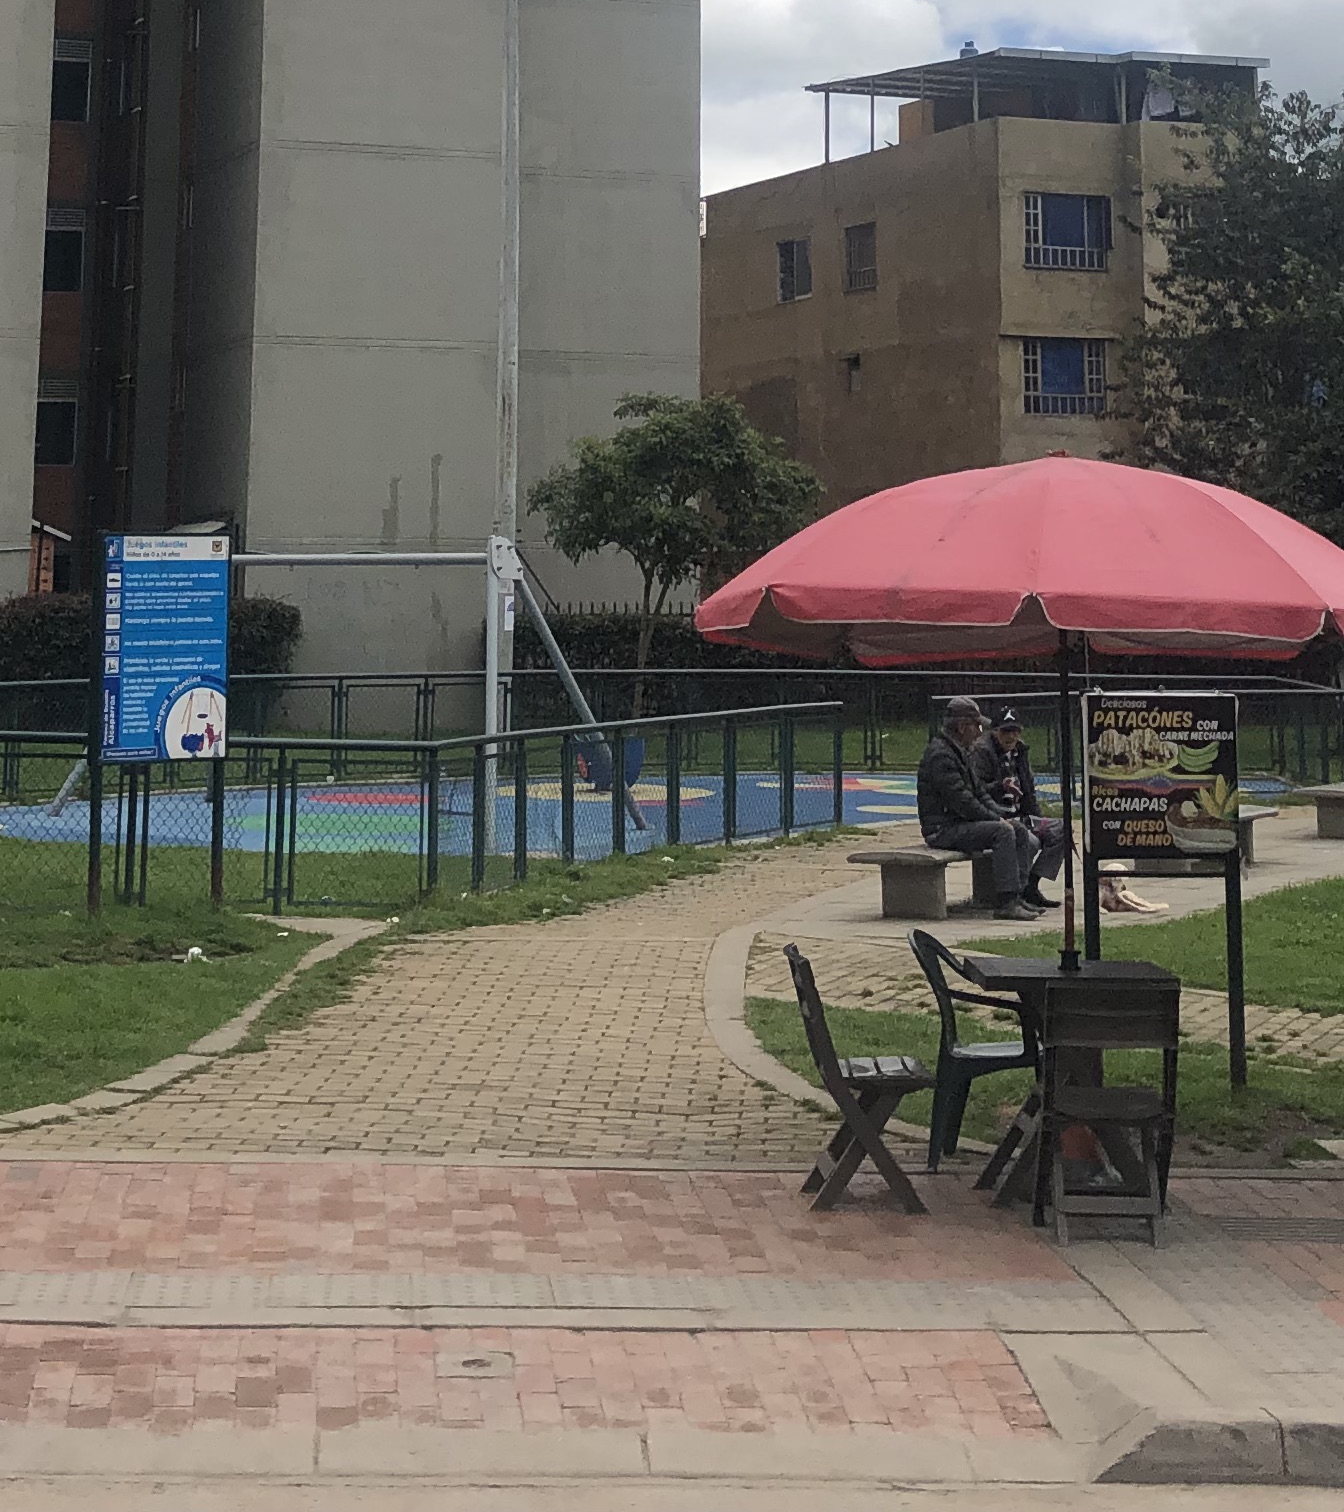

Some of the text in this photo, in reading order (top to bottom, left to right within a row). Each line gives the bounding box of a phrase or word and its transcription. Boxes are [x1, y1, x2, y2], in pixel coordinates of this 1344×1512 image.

[1092, 707, 1193, 728] PATACÓNES
[1196, 720, 1219, 731] CON
[1159, 731, 1234, 741] CARNE MECHADA
[1092, 797, 1168, 812] CACHAPAS
[1123, 820, 1165, 833] QUESO
[1117, 833, 1172, 846] DE MANO
